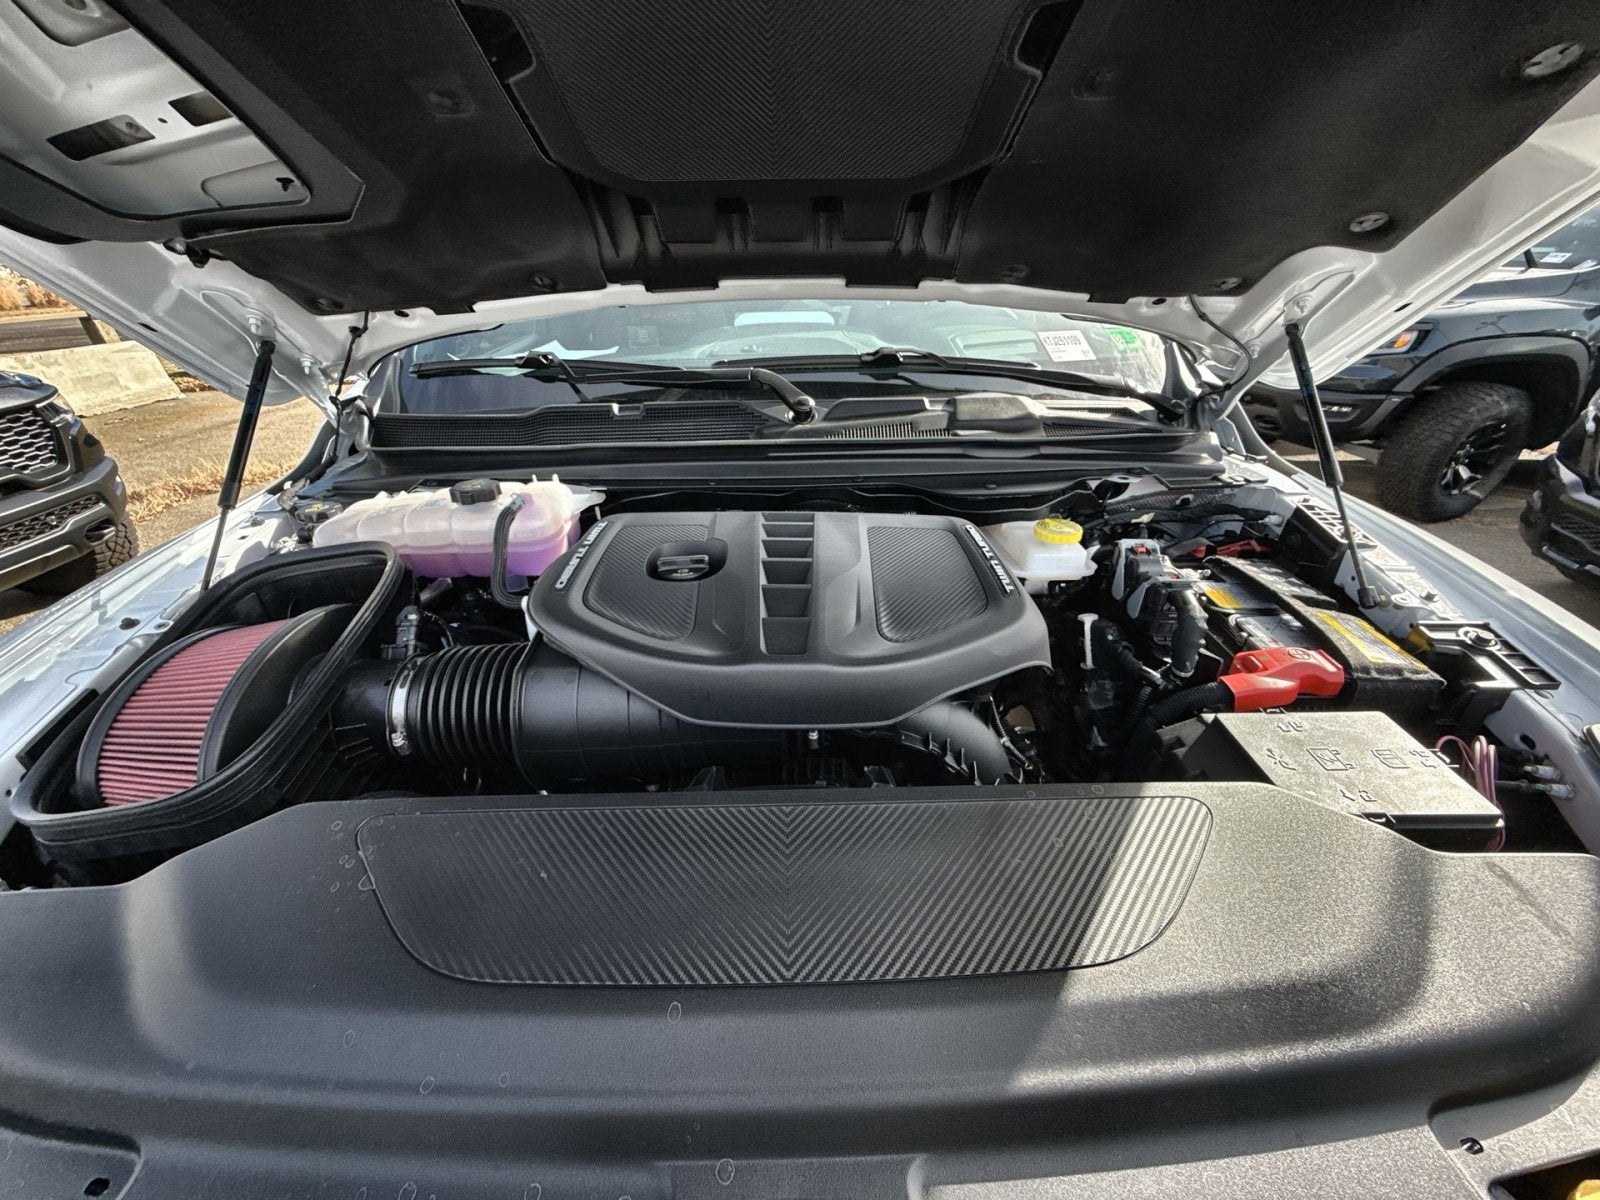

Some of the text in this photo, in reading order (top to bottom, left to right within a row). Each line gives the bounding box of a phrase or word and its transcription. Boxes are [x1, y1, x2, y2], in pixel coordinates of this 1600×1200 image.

[554, 521, 608, 589] TWIN TURBO
[965, 524, 1014, 593] TWIN TURBO
